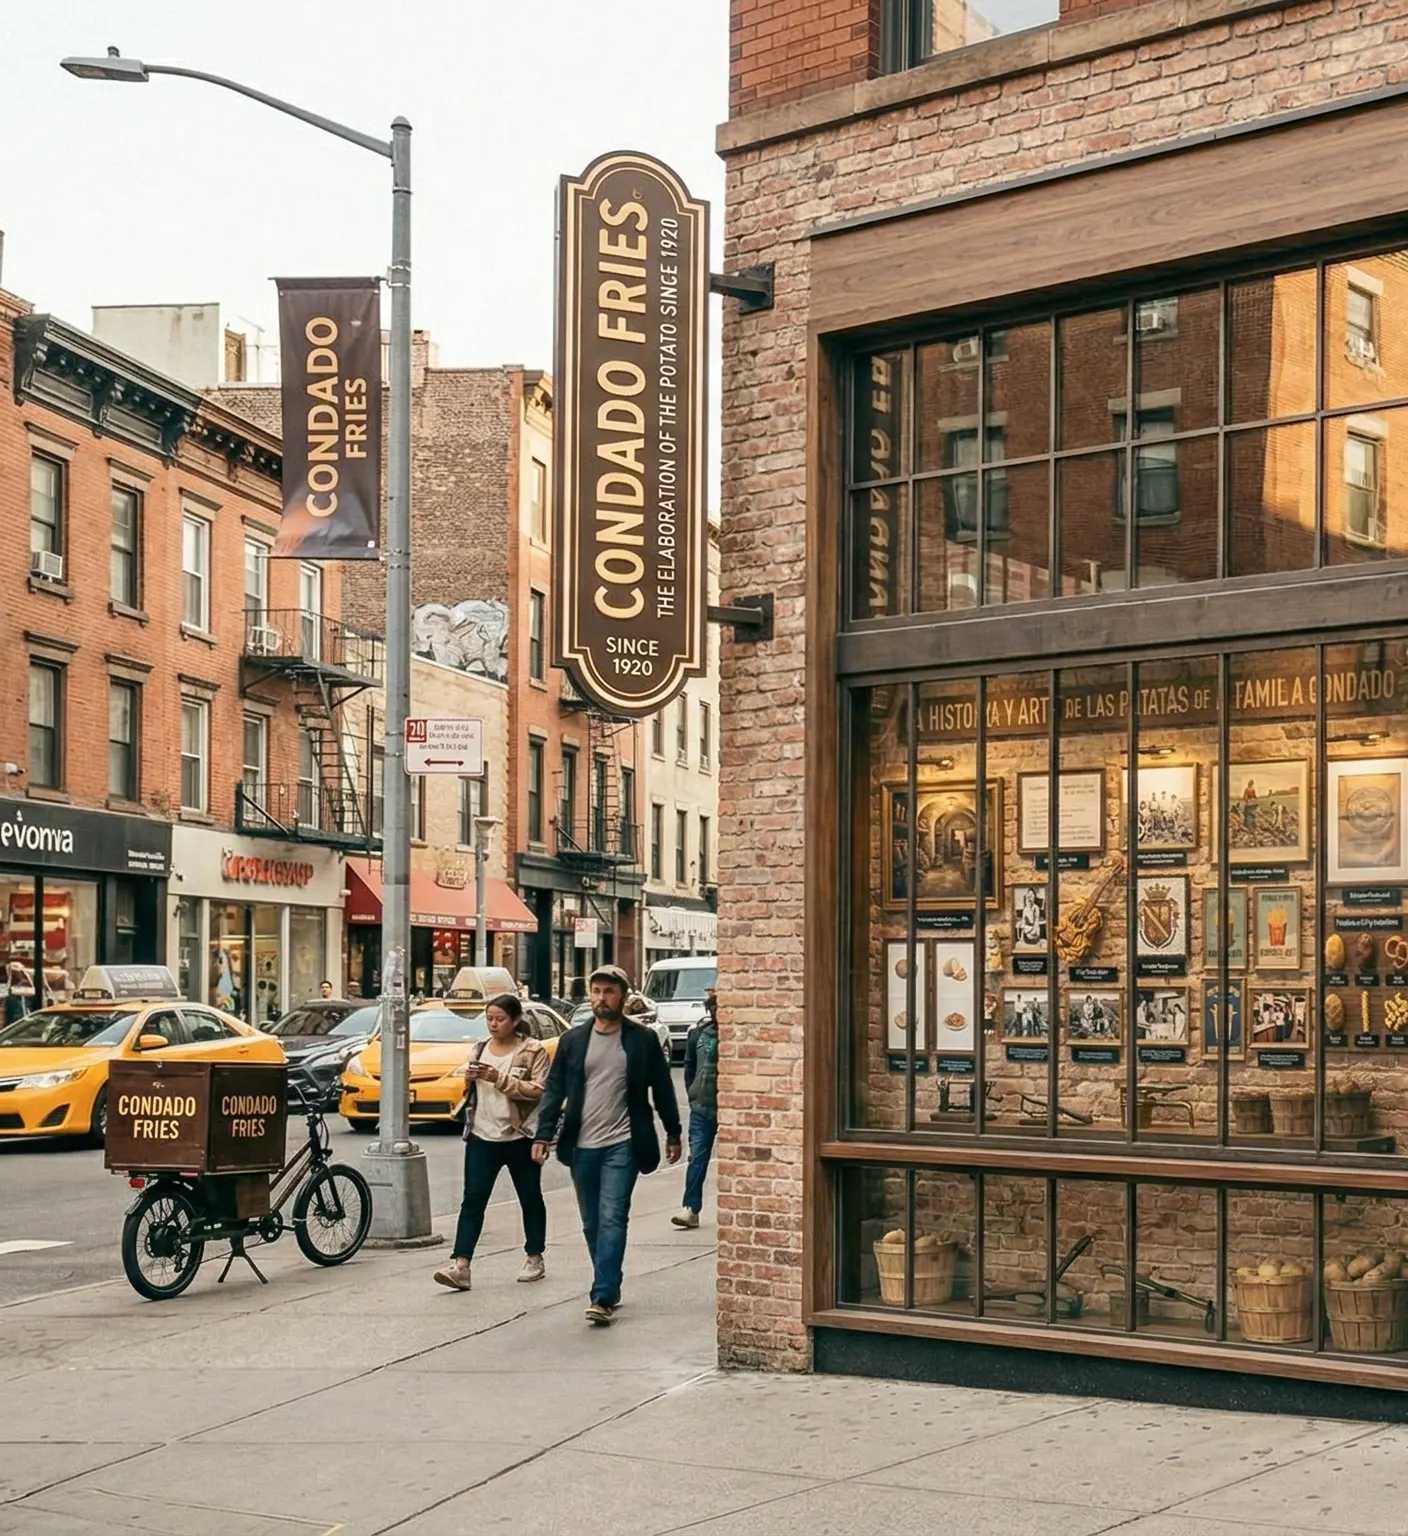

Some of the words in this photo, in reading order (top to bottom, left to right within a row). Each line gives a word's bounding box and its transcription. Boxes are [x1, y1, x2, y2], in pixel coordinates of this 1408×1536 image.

[661, 218, 679, 258] 1920
[598, 198, 649, 343] FRIES
[660, 263, 678, 316] SINCE
[659, 324, 678, 388] POTATO
[305, 316, 339, 518] CONDADO
[346, 376, 367, 459] FRIES
[659, 393, 677, 426] THE
[659, 430, 677, 454] OF
[594, 360, 647, 619] CONDADO
[657, 459, 677, 581] ELABORATION
[657, 586, 675, 618] THE
[606, 636, 659, 656] SINCE
[613, 658, 653, 676] 1920
[1003, 699, 1014, 726] Y
[1017, 696, 1050, 725] ART
[1087, 694, 1115, 718] LAS
[1119, 685, 1189, 716] PTATAS
[118, 1095, 196, 1117] CONDADO
[221, 1096, 277, 1115] CONDADO
[133, 1119, 179, 1139] FRIES
[232, 1119, 266, 1137] FRIES
